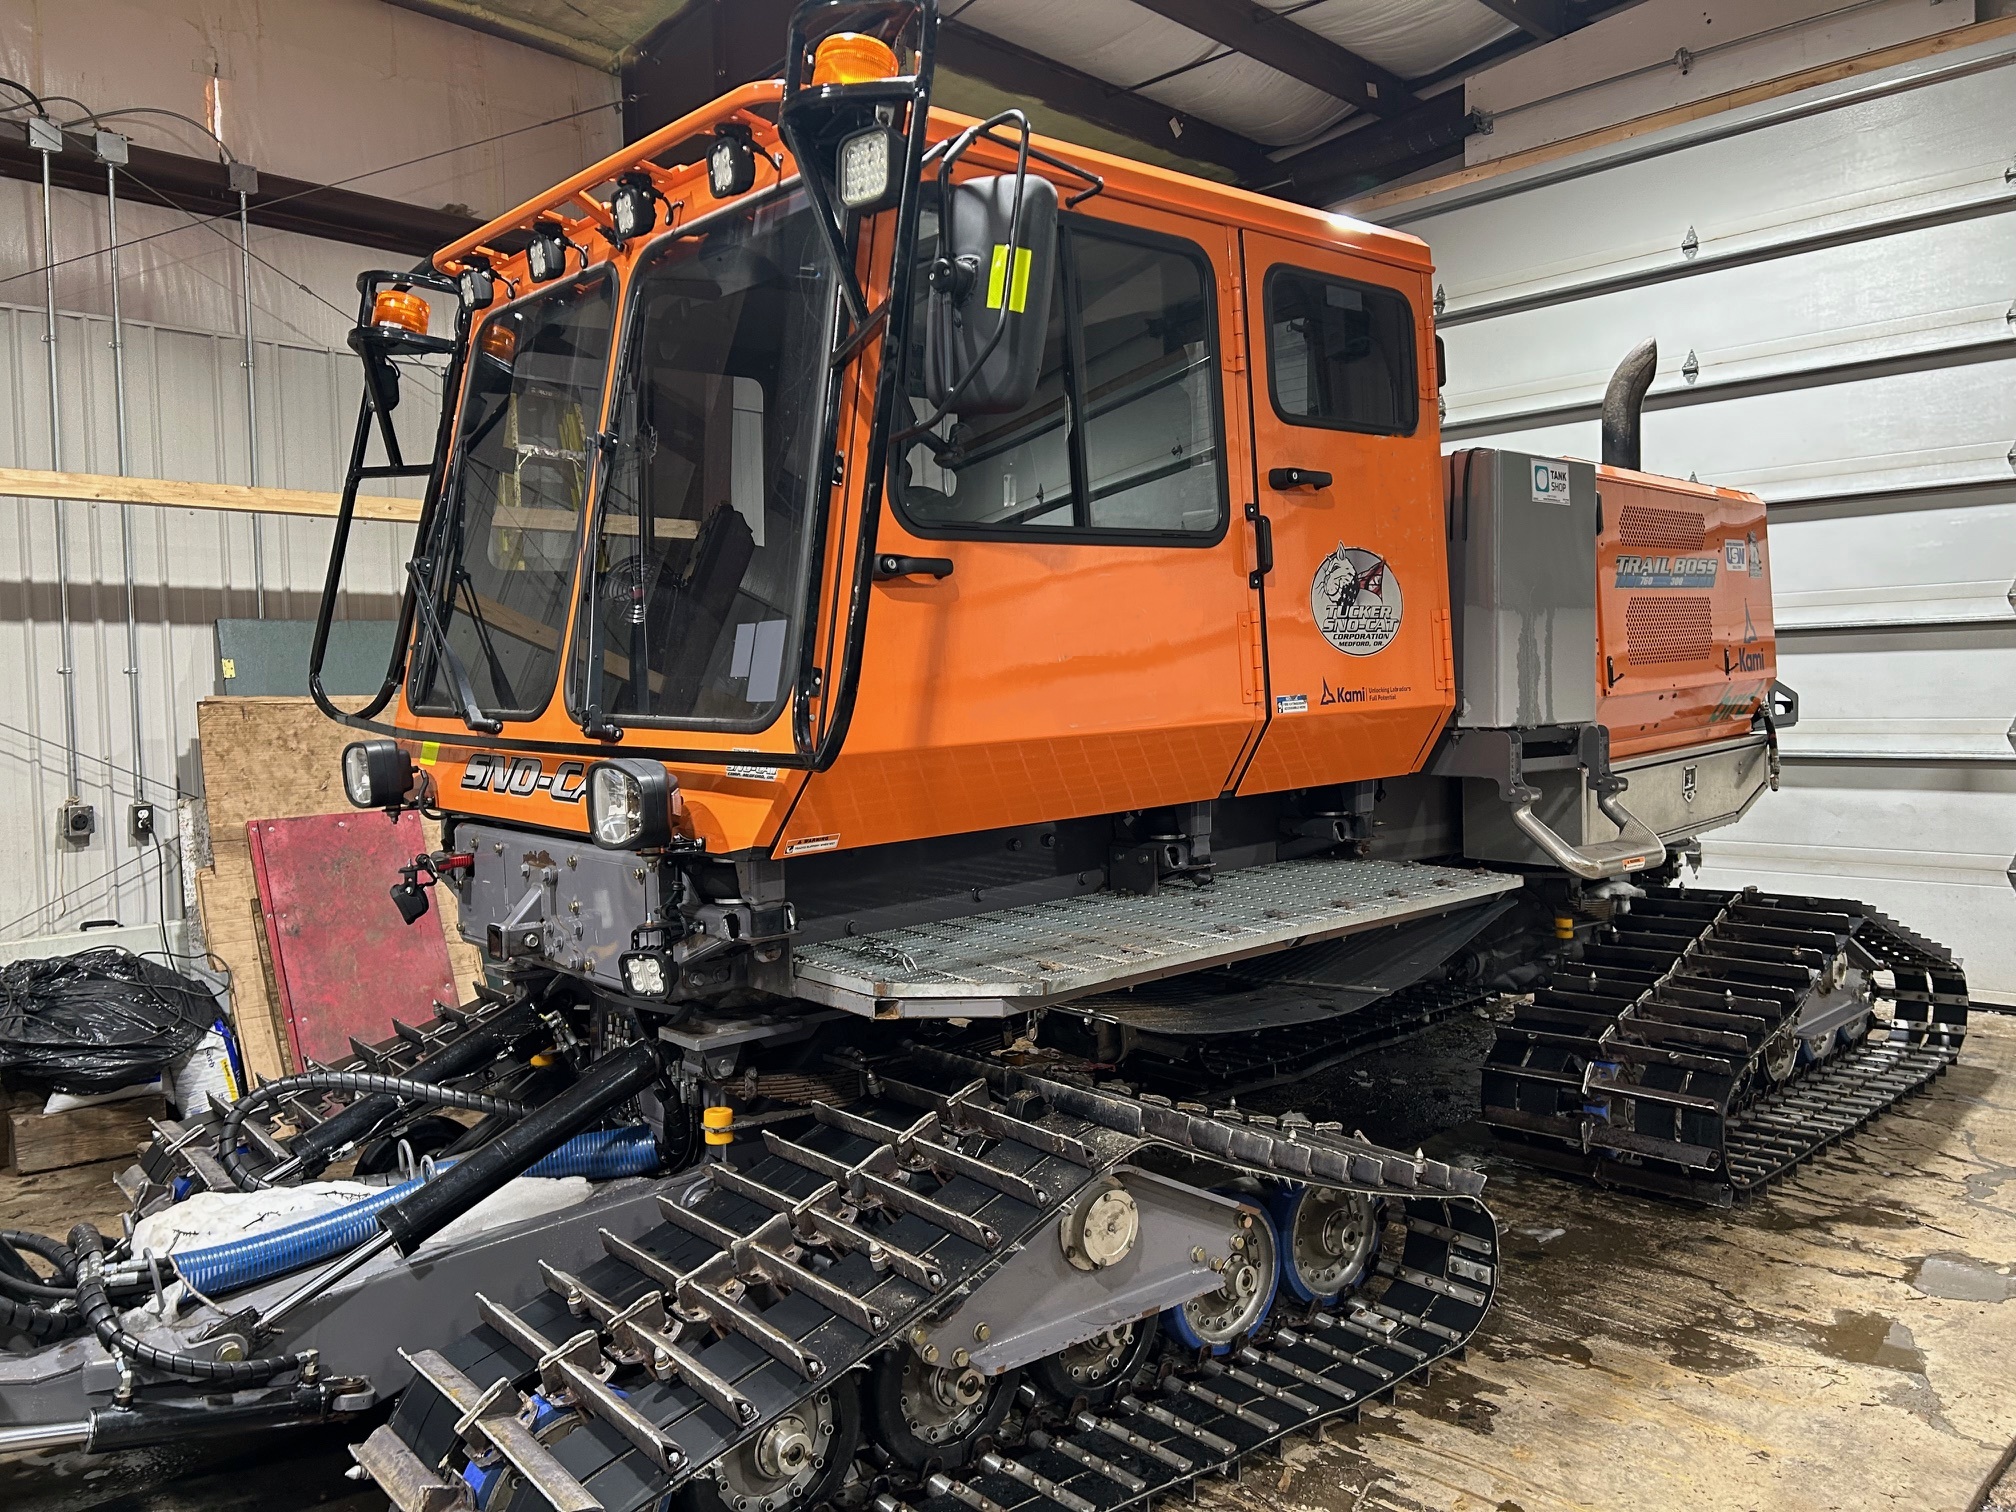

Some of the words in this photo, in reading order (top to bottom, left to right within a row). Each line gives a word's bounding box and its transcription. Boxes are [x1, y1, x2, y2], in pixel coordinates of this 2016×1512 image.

[1550, 470, 1567, 481] TANK
[1551, 482, 1566, 492] SHOP
[1616, 555, 1671, 576] TRAIL
[1671, 558, 1718, 576] BOSS
[1325, 605, 1393, 619] TUCKER
[1322, 618, 1400, 632] SNO-CAT
[1739, 647, 1765, 672] Kami
[1337, 687, 1365, 703] Kami
